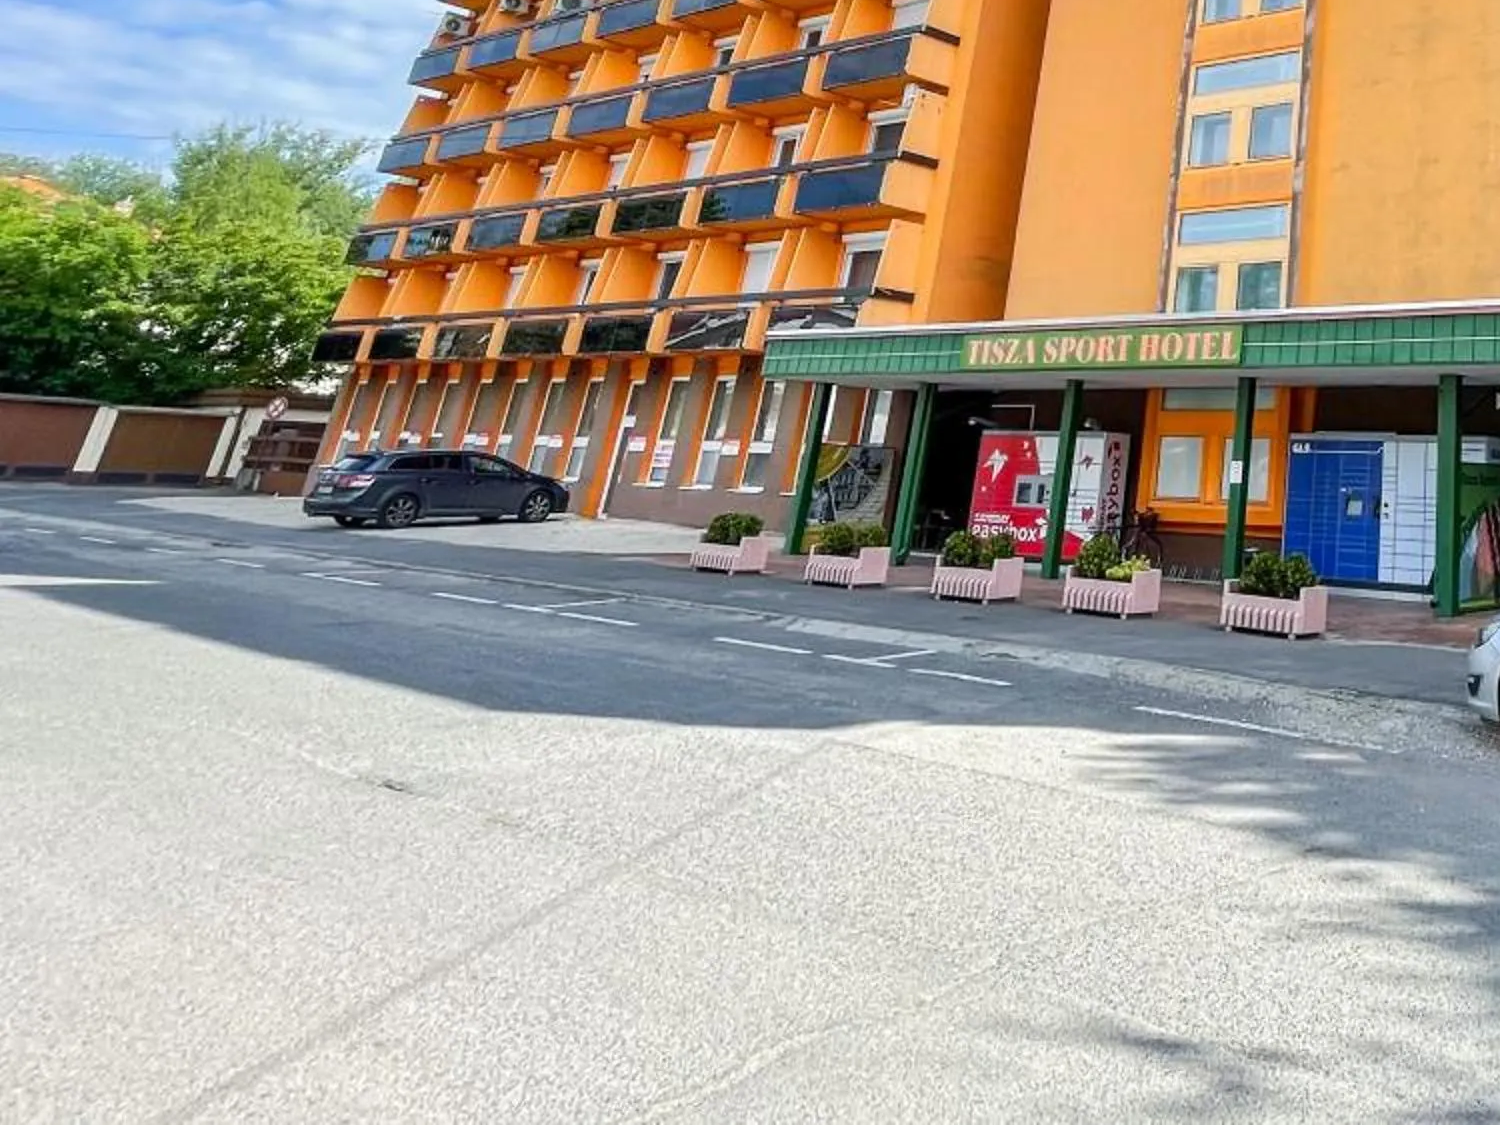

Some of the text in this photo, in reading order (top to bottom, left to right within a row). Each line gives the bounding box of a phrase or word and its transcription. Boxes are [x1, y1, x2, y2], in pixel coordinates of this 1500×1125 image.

[968, 331, 1238, 366] TISZA SPORT HOTEL
